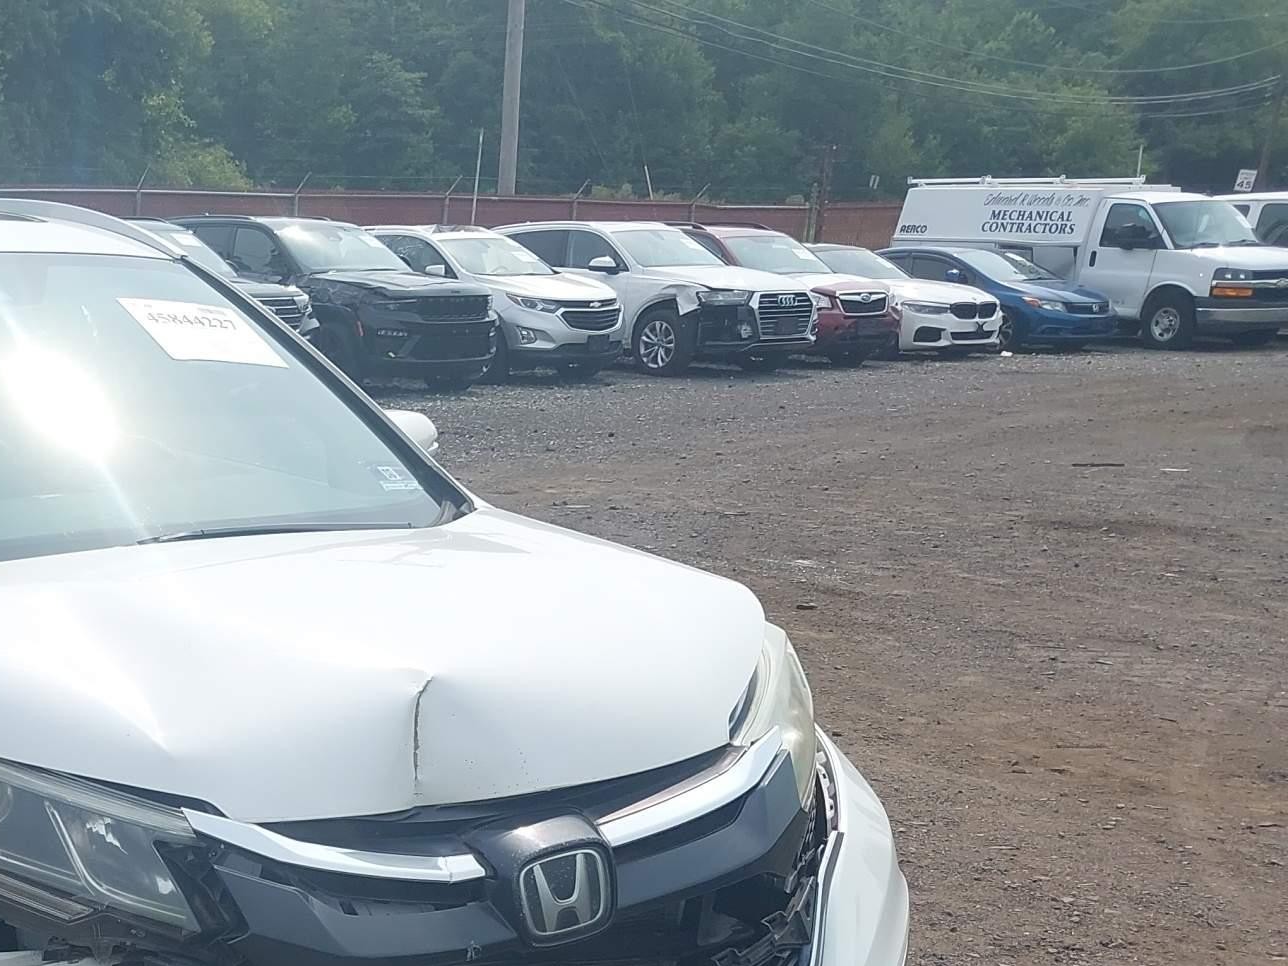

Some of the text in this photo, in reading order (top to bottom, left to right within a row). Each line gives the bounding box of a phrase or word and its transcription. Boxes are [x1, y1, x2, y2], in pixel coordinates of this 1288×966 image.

[1237, 181, 1251, 189] 45
[989, 209, 1073, 222] MECHANICAL
[981, 221, 1076, 234] CONTRACTORS
[147, 312, 237, 330] 45844227
